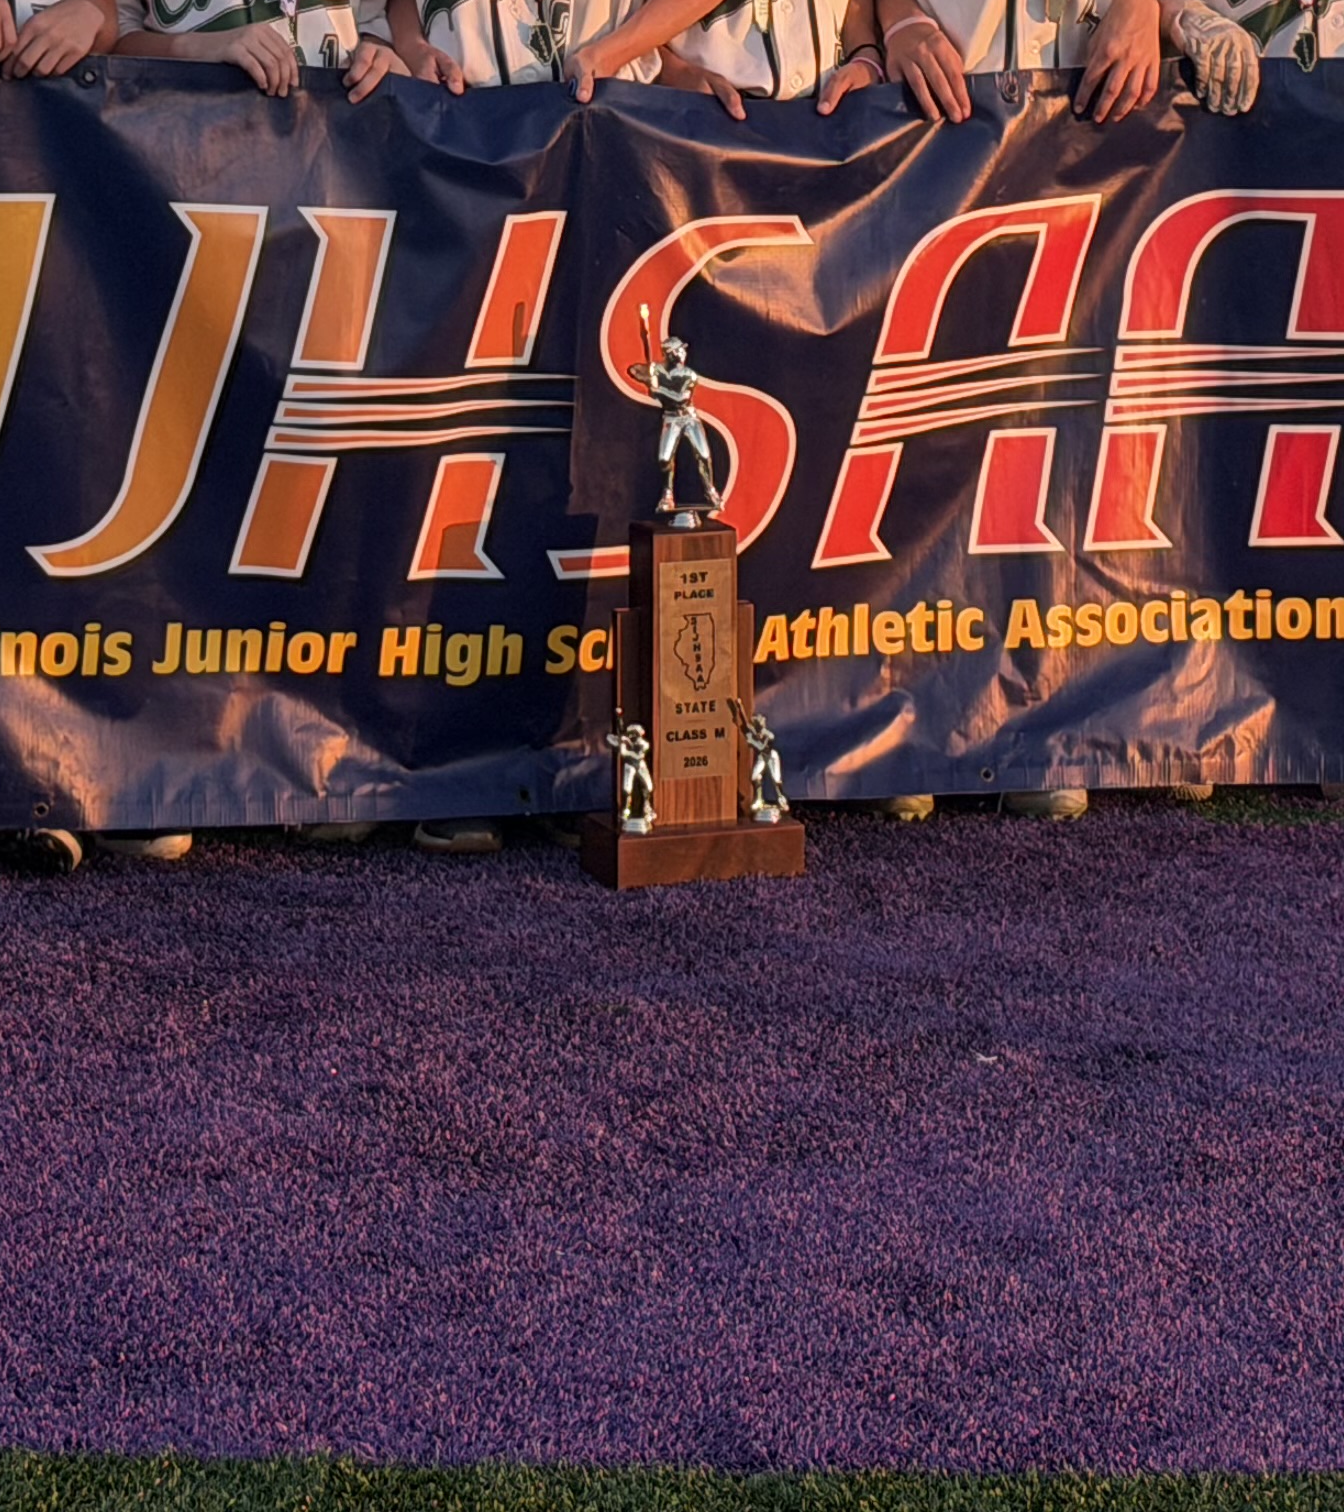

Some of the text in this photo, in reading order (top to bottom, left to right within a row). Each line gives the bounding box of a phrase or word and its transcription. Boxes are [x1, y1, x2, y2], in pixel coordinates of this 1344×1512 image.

[680, 572, 708, 584] 1ST
[674, 589, 714, 600] PLACE
[151, 620, 357, 675] Junior
[377, 624, 522, 686] High
[754, 597, 985, 663] Athletic
[676, 701, 716, 714] STATE
[666, 728, 725, 742] CLASS M
